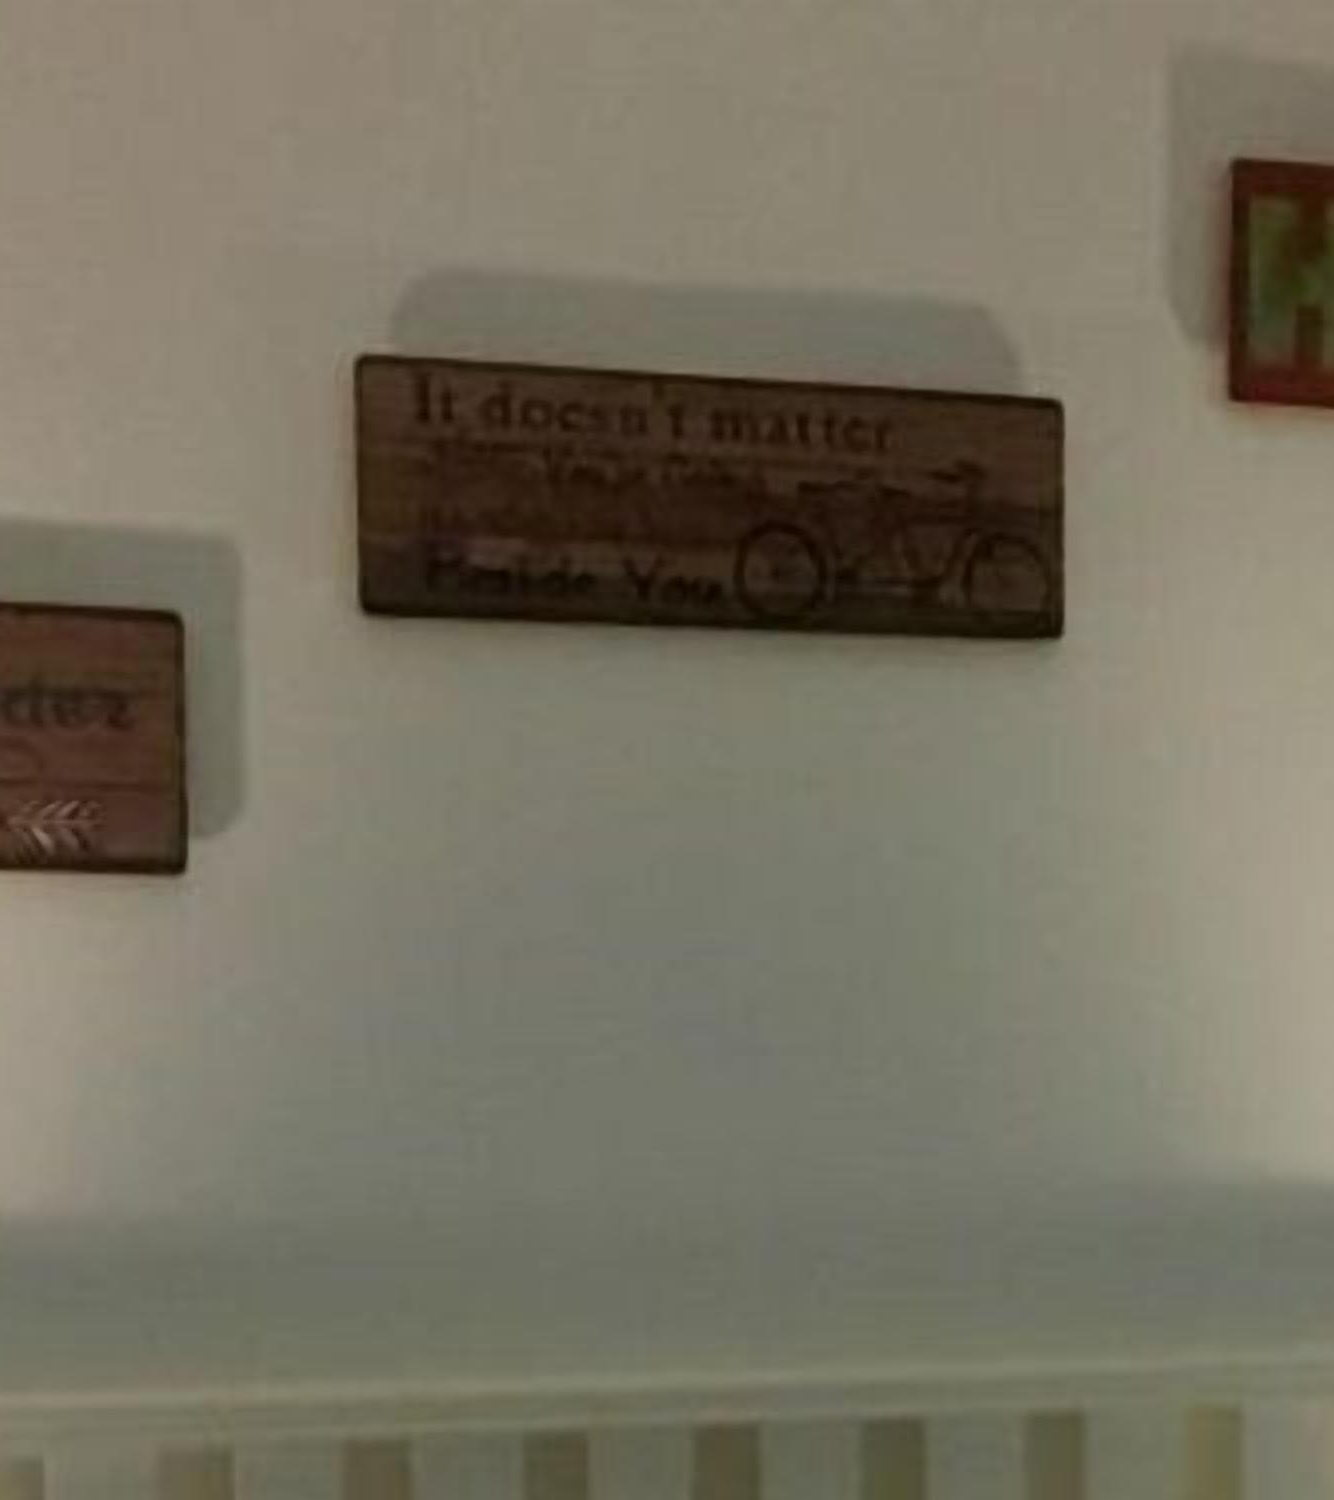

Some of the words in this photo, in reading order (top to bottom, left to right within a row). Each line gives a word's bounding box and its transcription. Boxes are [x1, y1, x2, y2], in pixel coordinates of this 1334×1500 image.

[413, 371, 455, 425] It
[477, 377, 685, 440] doesn't
[710, 402, 895, 455] matter
